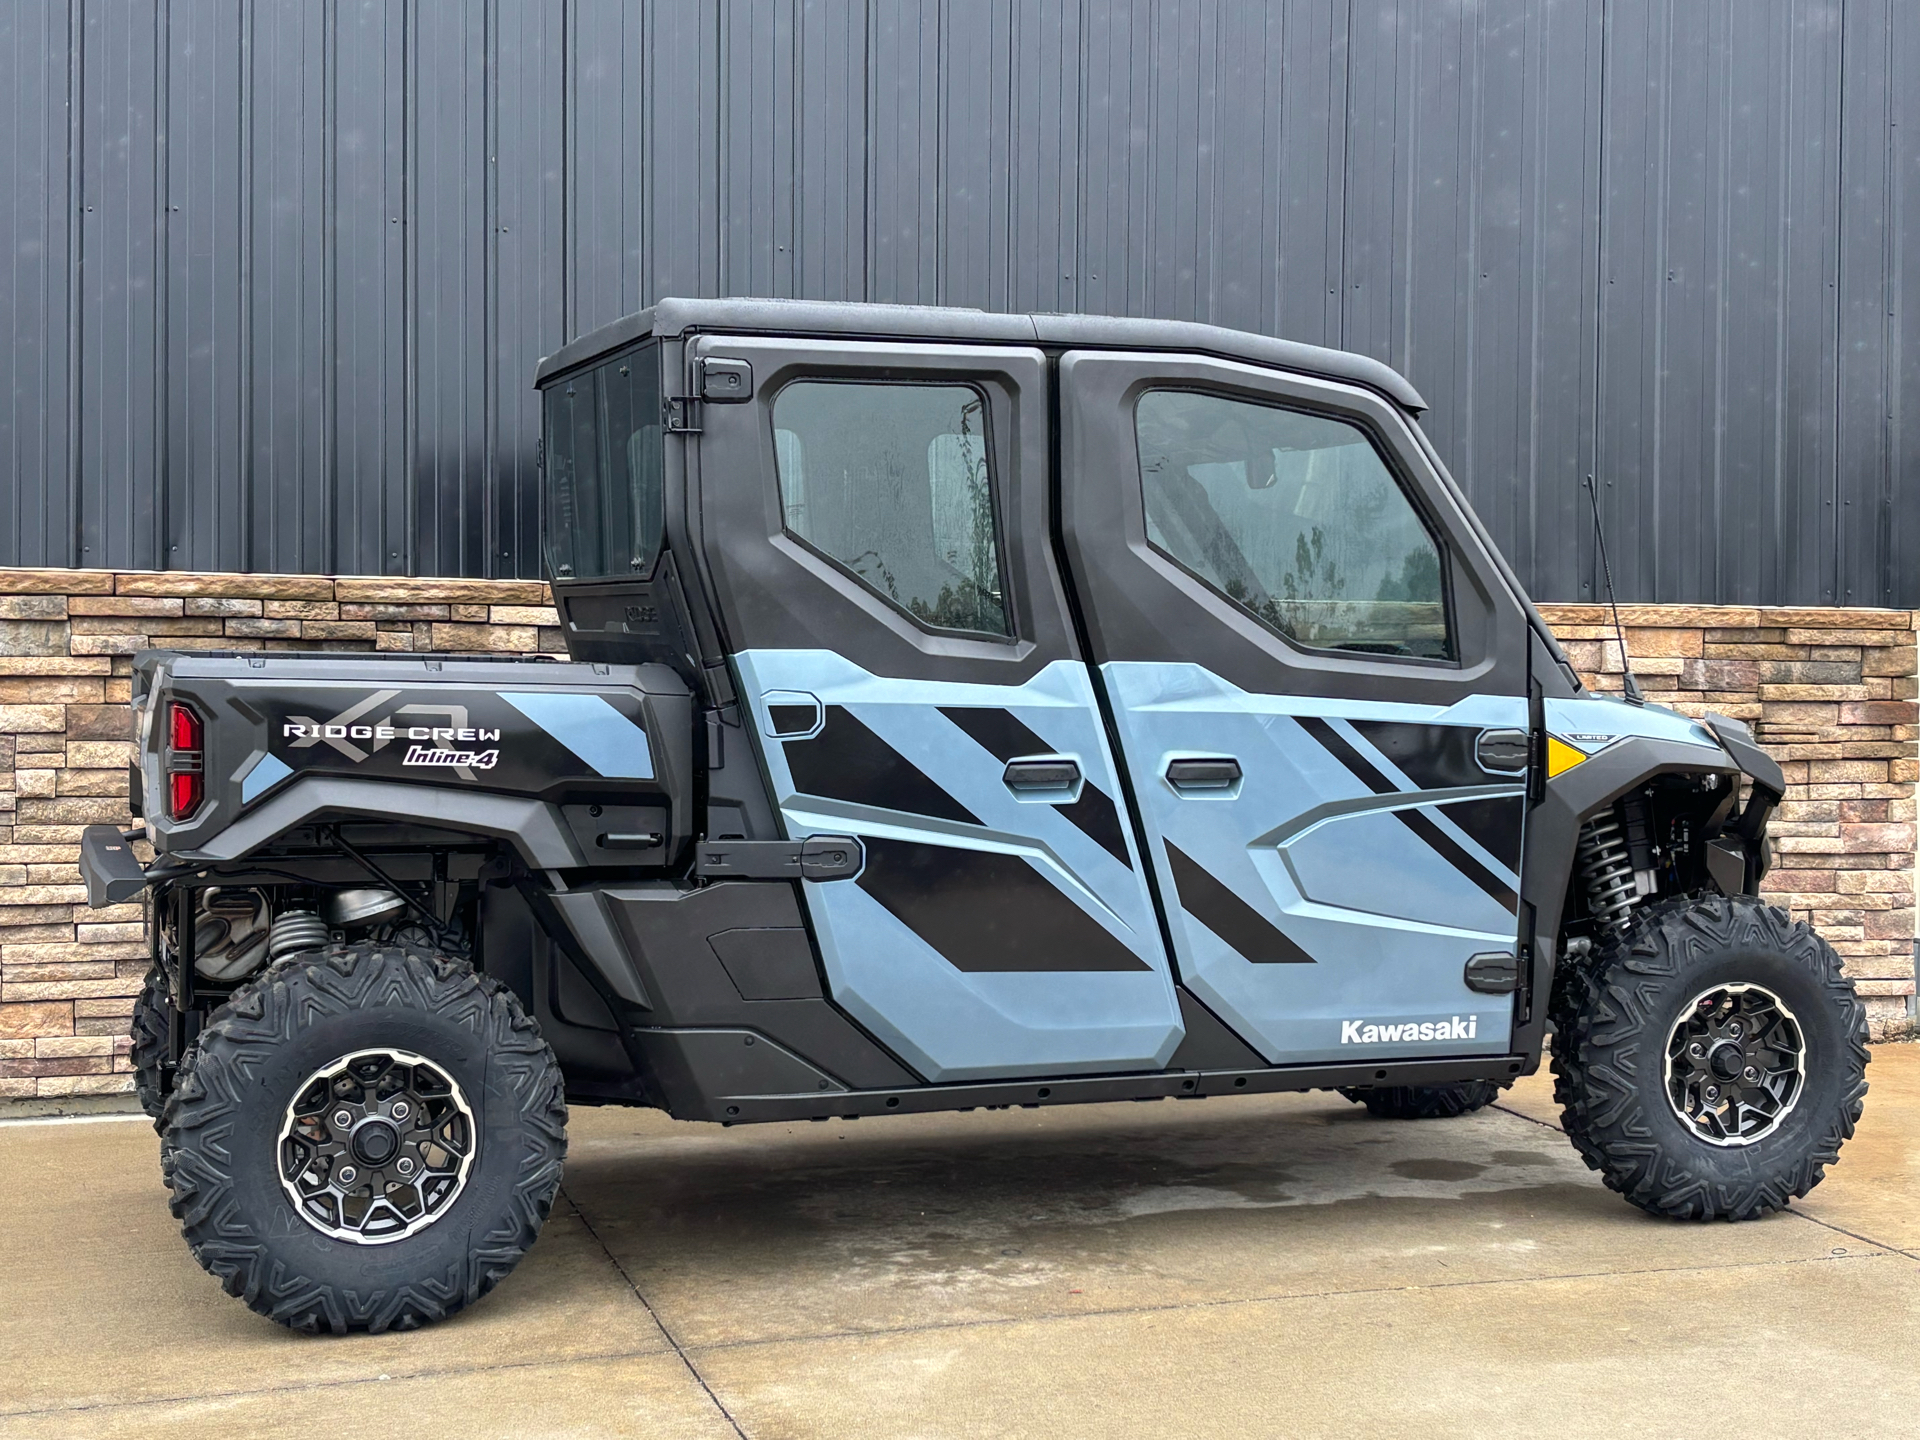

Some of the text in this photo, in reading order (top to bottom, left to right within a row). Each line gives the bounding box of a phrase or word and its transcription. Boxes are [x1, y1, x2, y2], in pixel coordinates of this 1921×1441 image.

[283, 724, 500, 742] RIDGE CREW
[402, 745, 500, 769] Inline-4
[1340, 1015, 1477, 1044] Kawasaki
